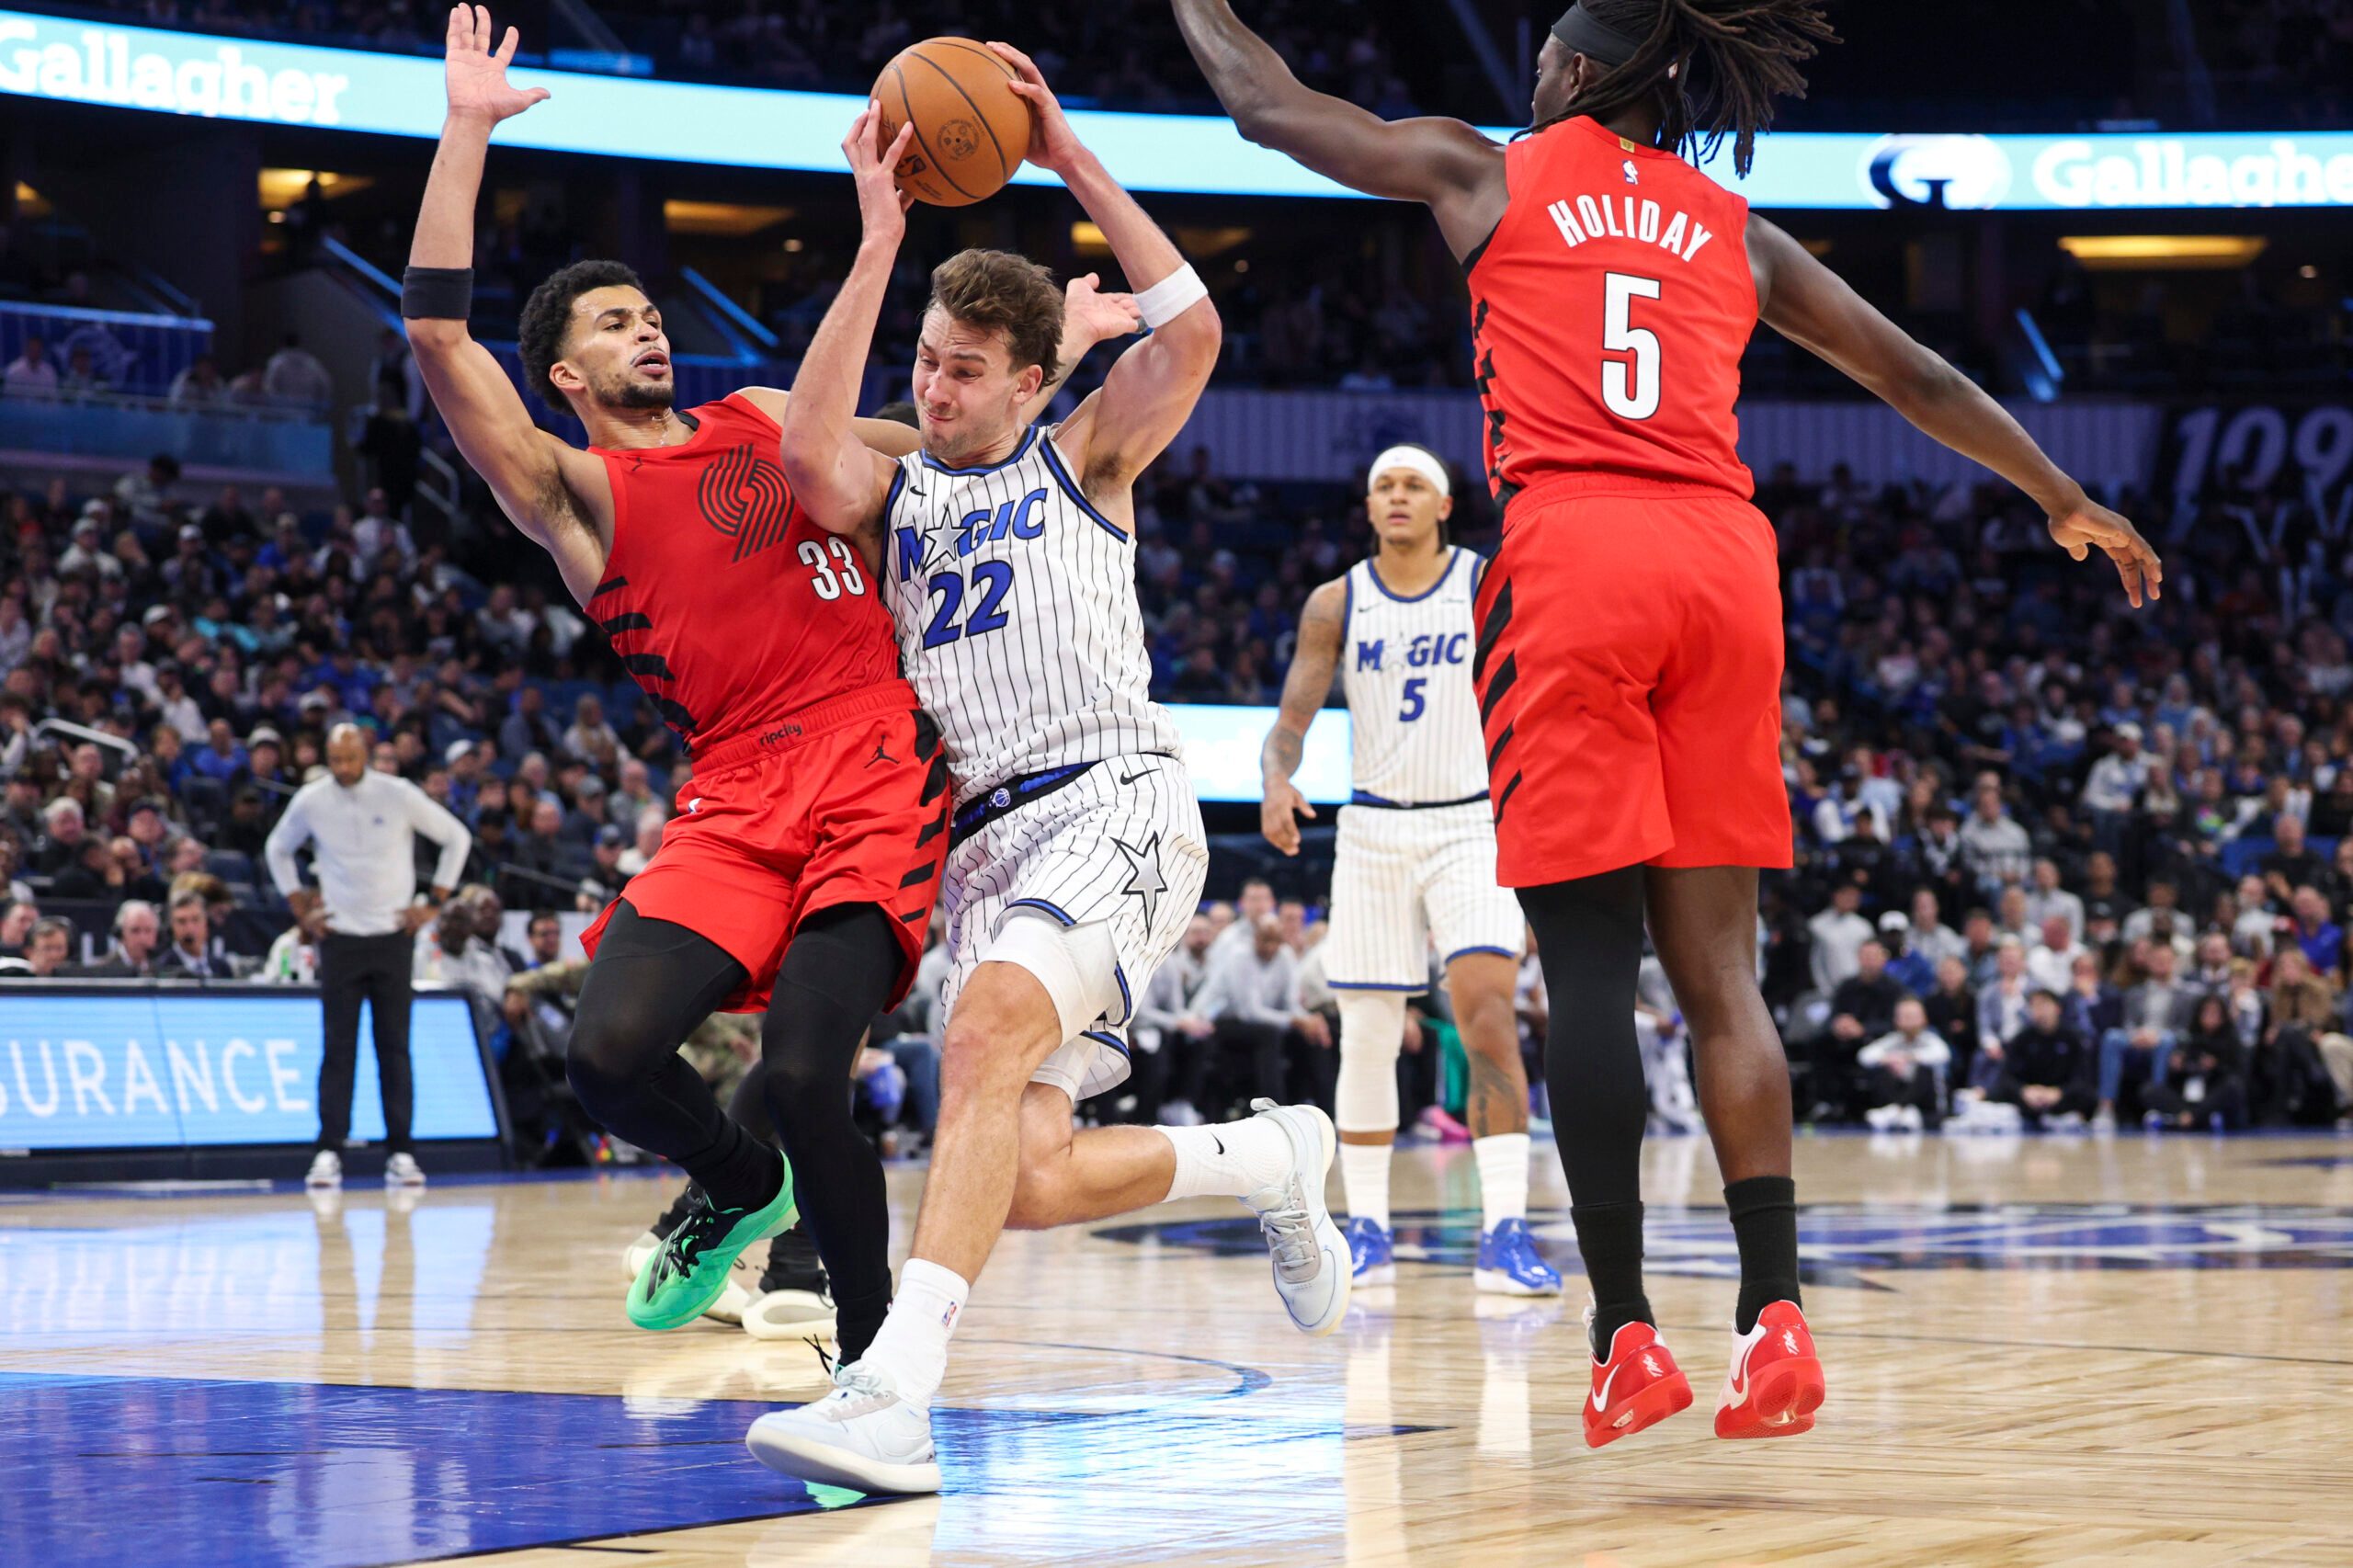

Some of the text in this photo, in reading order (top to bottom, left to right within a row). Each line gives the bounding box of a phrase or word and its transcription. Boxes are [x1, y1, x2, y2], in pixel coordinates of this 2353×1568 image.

[0, 19, 349, 124] Gallagher
[1546, 194, 1713, 263] HOLIDAY
[1601, 270, 1662, 421] 5
[796, 536, 866, 600] 33
[922, 559, 1014, 651] 22
[1398, 677, 1428, 722] 5
